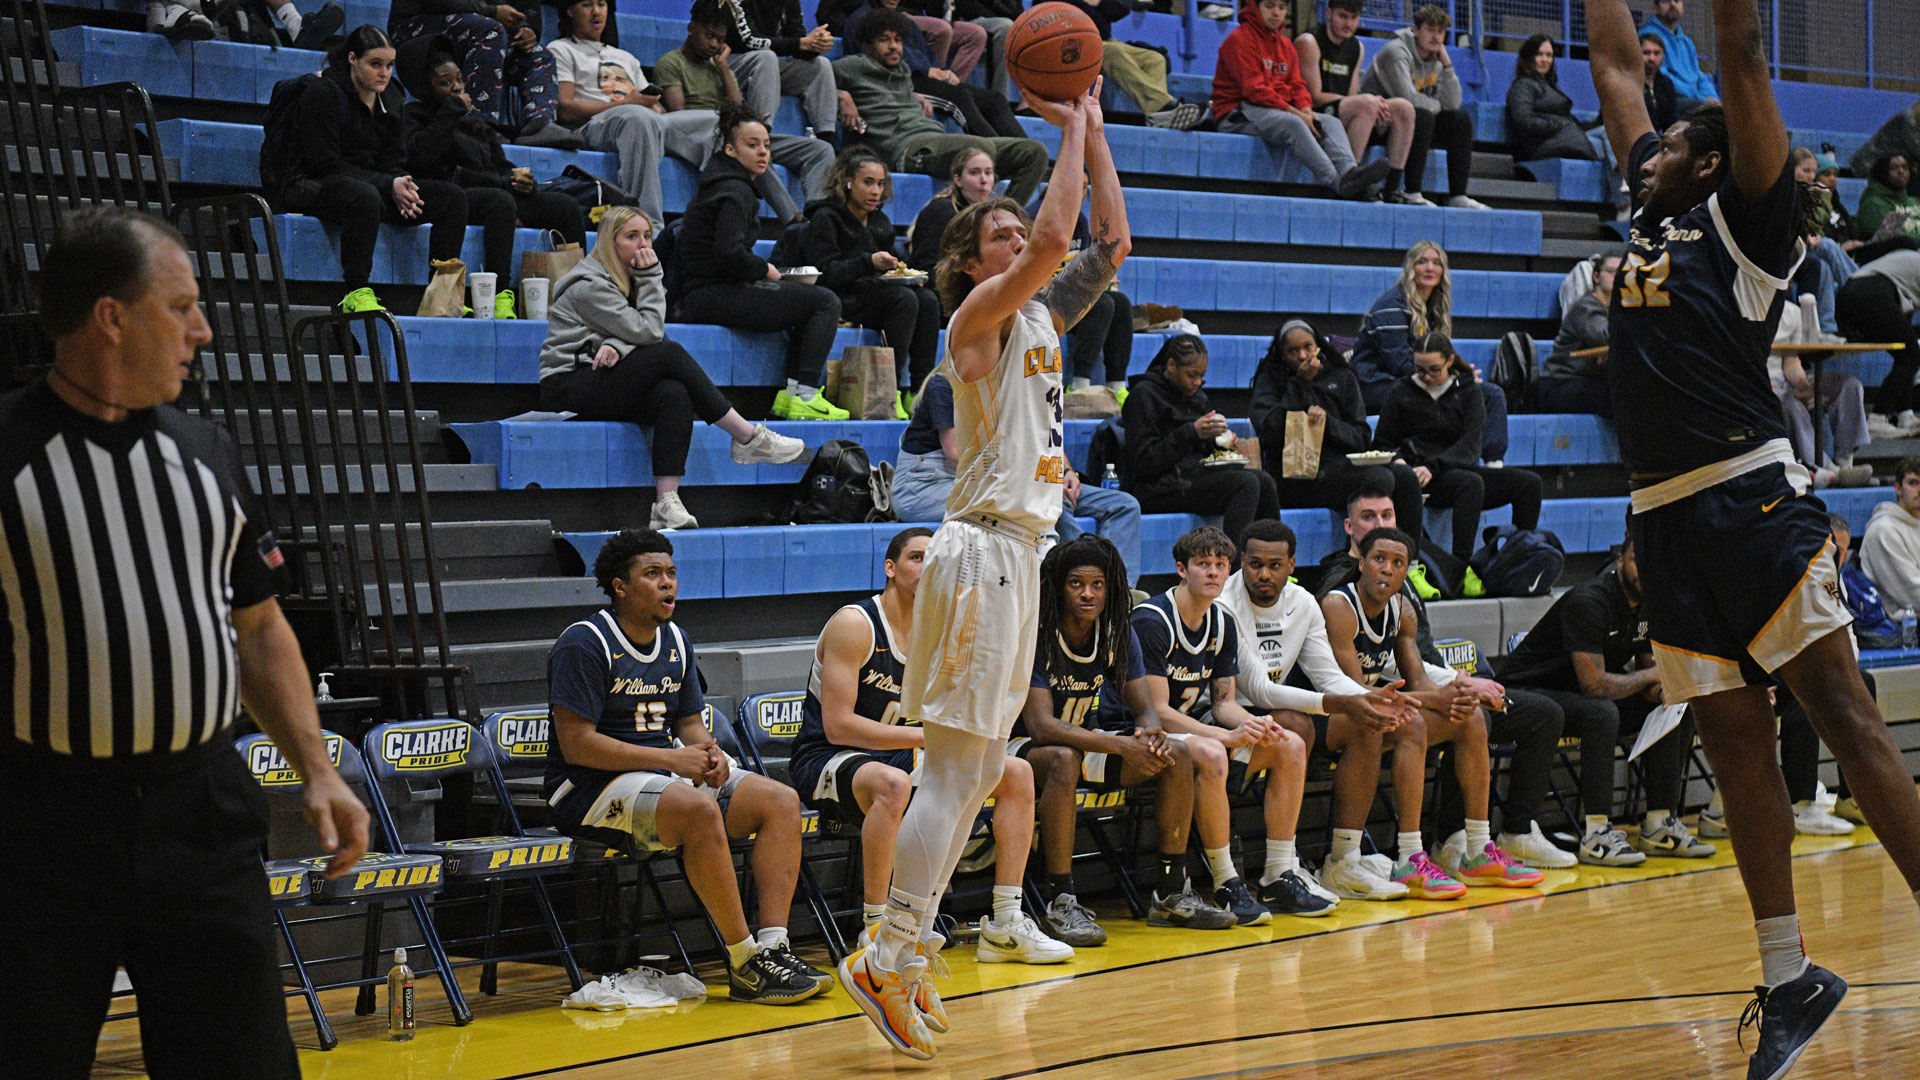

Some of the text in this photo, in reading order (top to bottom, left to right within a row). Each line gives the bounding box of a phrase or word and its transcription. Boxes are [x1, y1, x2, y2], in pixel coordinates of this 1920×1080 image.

[1619, 251, 1671, 308] 32
[1438, 644, 1475, 664] LARKE
[610, 677, 659, 695] William
[862, 669, 902, 695] Willia
[634, 702, 667, 732] 13
[761, 701, 804, 727] CLAR
[1060, 696, 1093, 727] 10
[386, 727, 467, 759] CLARKE
[501, 720, 549, 746] CLAR
[410, 755, 449, 766] PRIDE
[523, 743, 549, 752] PRI
[488, 842, 571, 869] PRIDE
[353, 864, 441, 891] PRIDE
